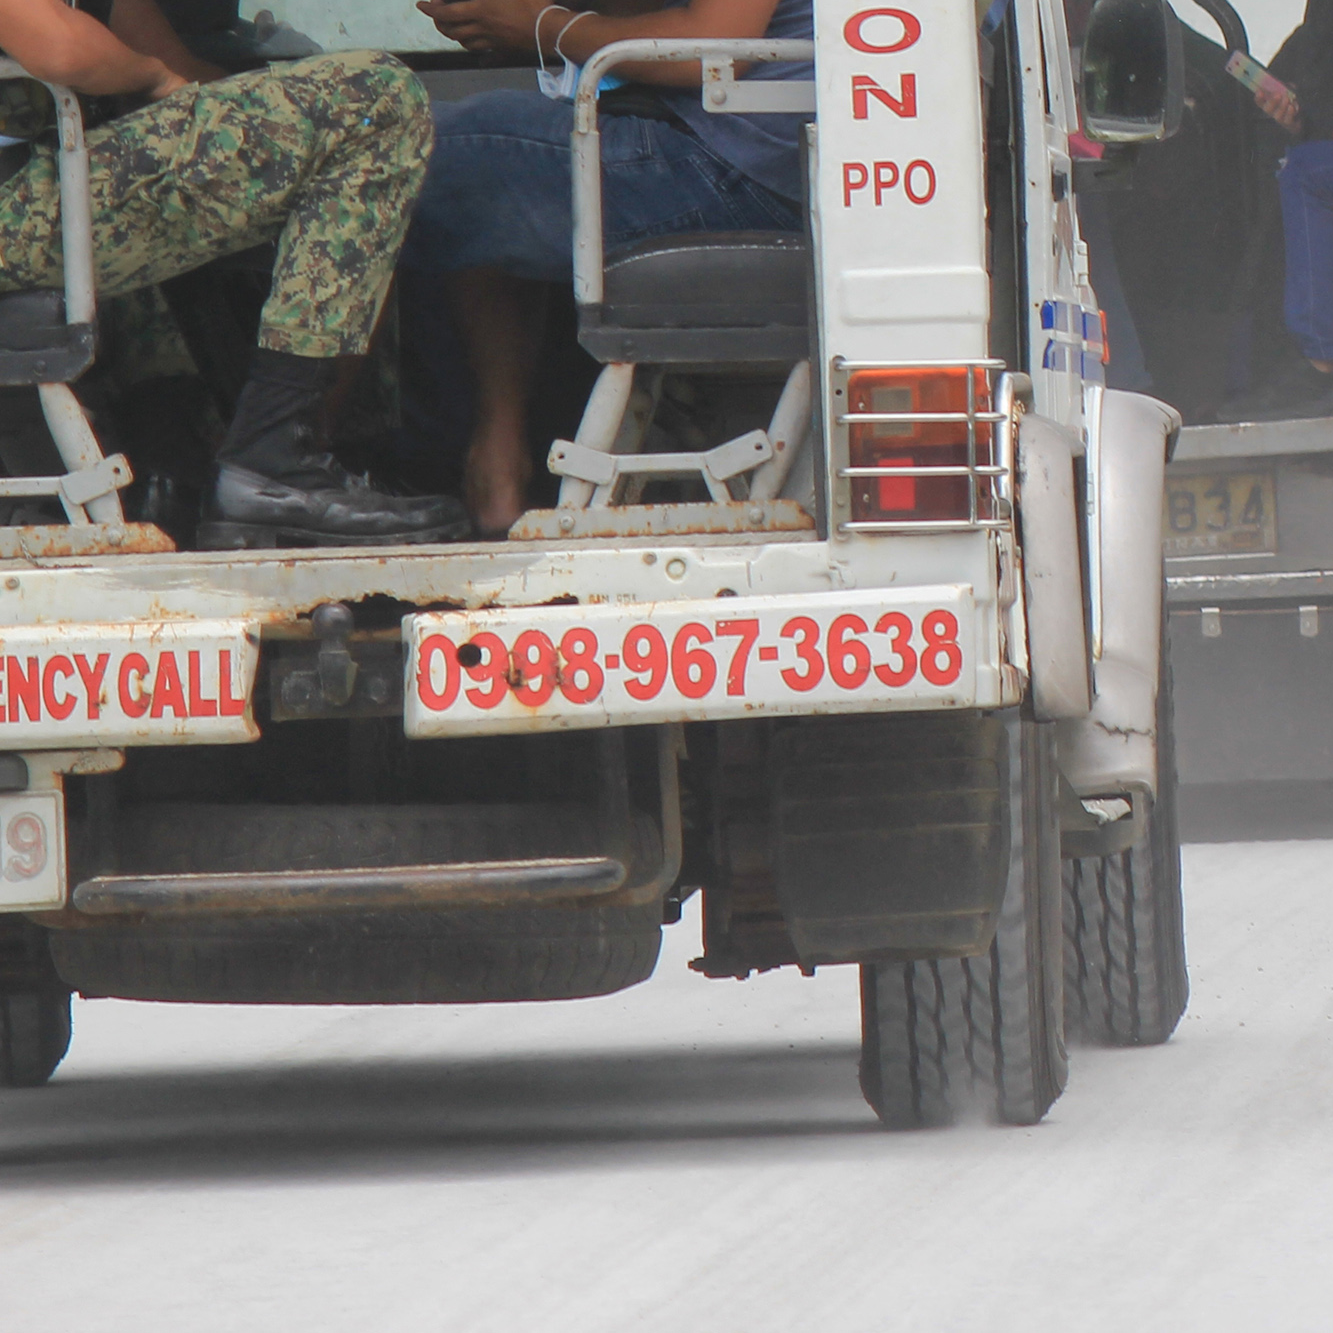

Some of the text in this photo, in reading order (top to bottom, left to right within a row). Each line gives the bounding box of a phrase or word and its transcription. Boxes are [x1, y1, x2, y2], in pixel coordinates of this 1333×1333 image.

[842, 160, 937, 208] PPO
[0, 649, 246, 723] NCY CALL
[416, 609, 963, 713] 0998-967-3638
